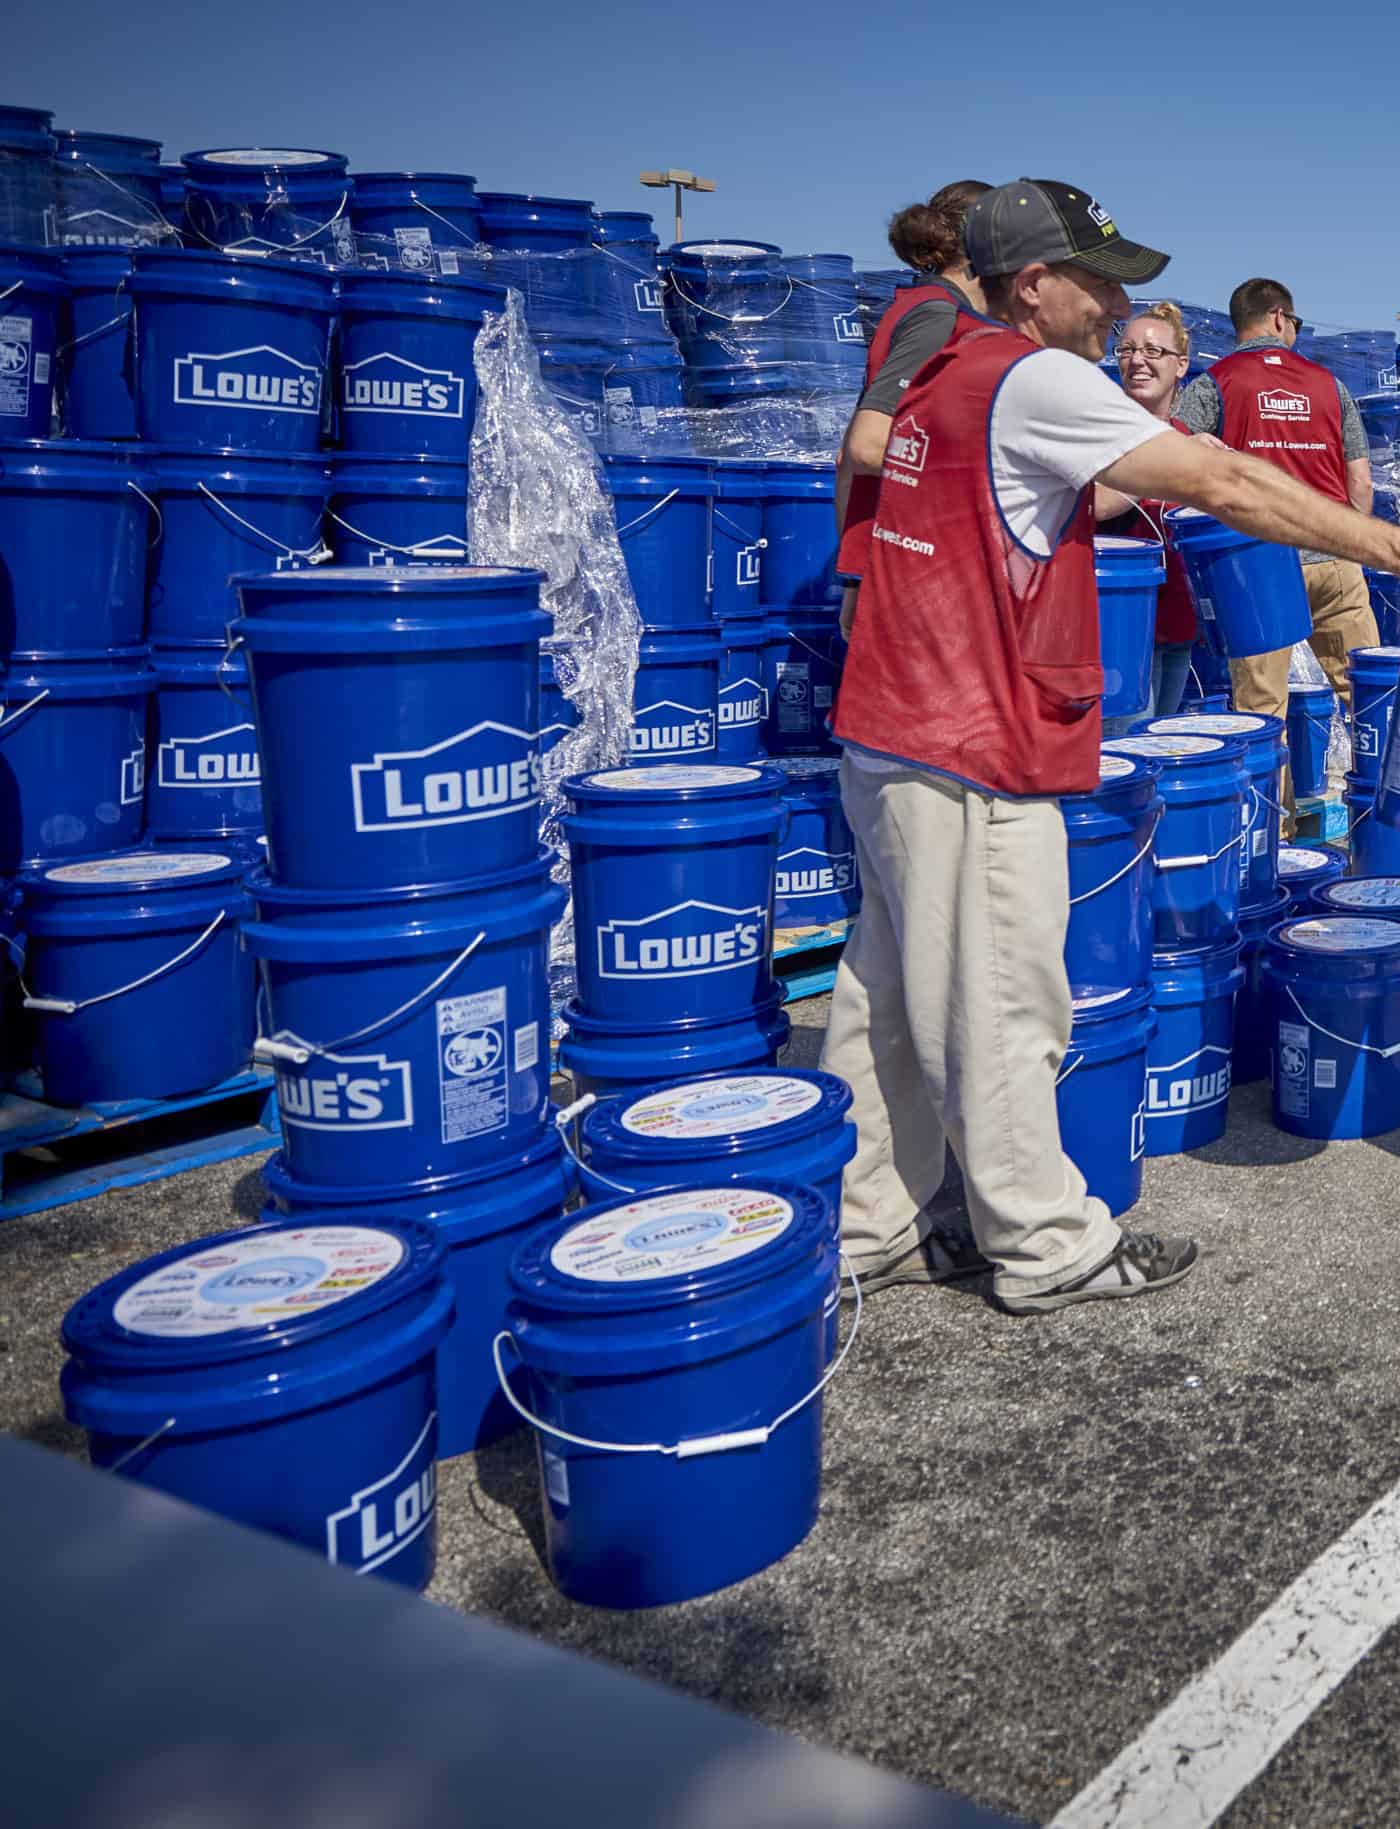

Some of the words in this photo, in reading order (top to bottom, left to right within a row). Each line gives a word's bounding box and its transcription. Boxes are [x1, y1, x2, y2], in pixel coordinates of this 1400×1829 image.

[192, 365, 315, 407] LOWE'S
[1264, 395, 1305, 411] LOWE'S
[630, 719, 710, 751] OWE'S
[175, 749, 261, 780] LOW
[776, 863, 849, 893] OWE'S
[614, 922, 759, 970] LOWE'S
[280, 1072, 384, 1120] WE'S
